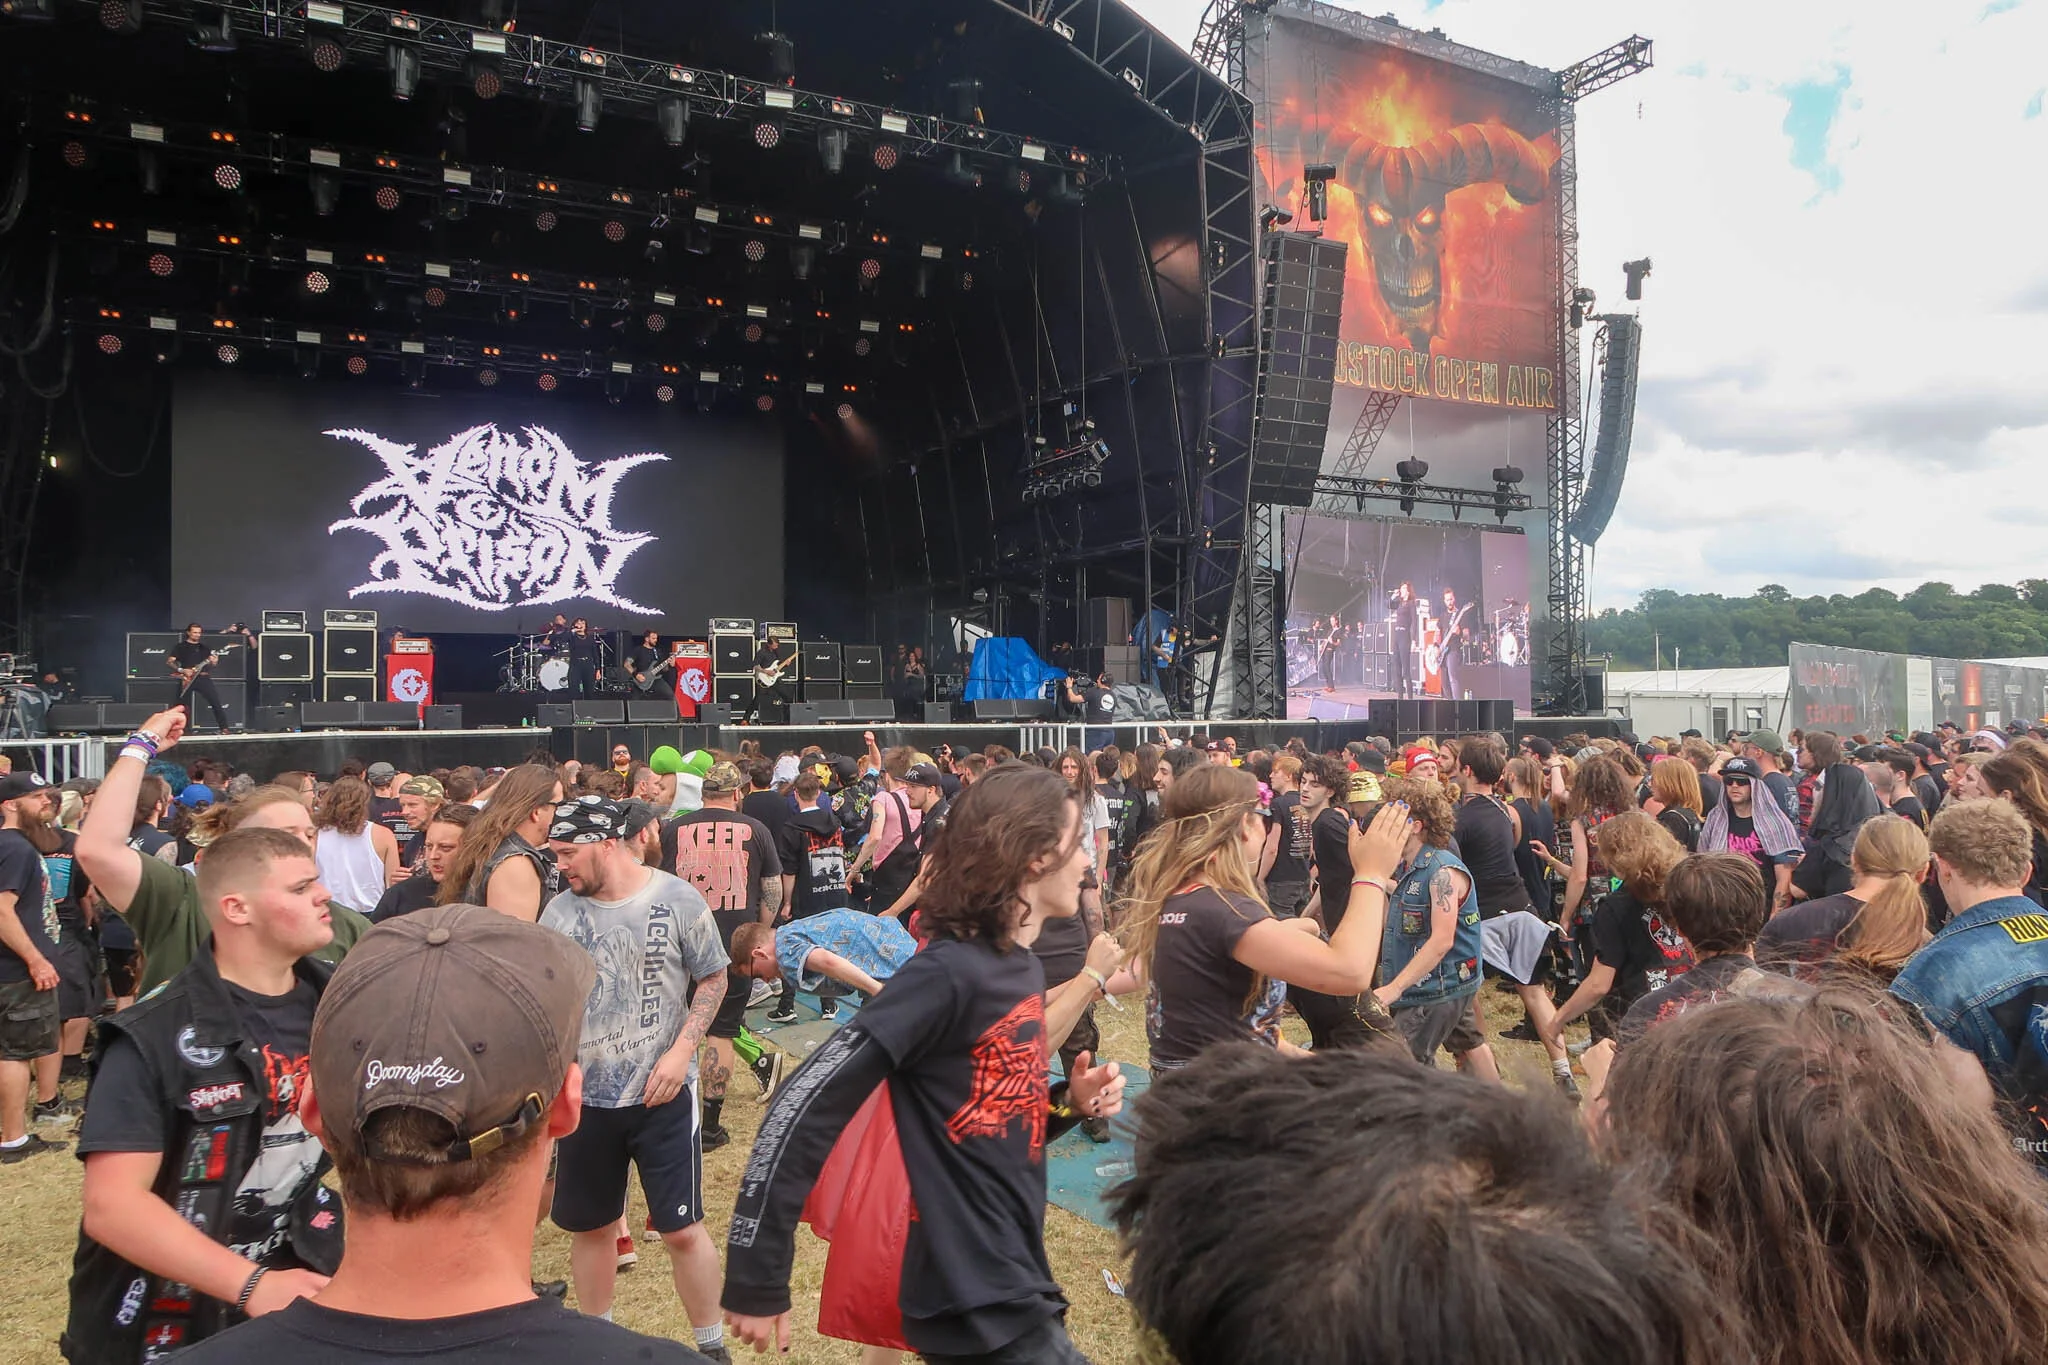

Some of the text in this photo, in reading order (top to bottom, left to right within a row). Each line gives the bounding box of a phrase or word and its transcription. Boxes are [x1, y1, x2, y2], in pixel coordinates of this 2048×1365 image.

[1434, 354, 1500, 405] OPEN
[1506, 365, 1555, 409] AIR
[677, 821, 752, 852] KEEP
[640, 903, 671, 1029] ACHILLES
[580, 1025, 625, 1049] mmortal
[606, 1027, 663, 1055] Warrior
[365, 1056, 465, 1089] Doomsday
